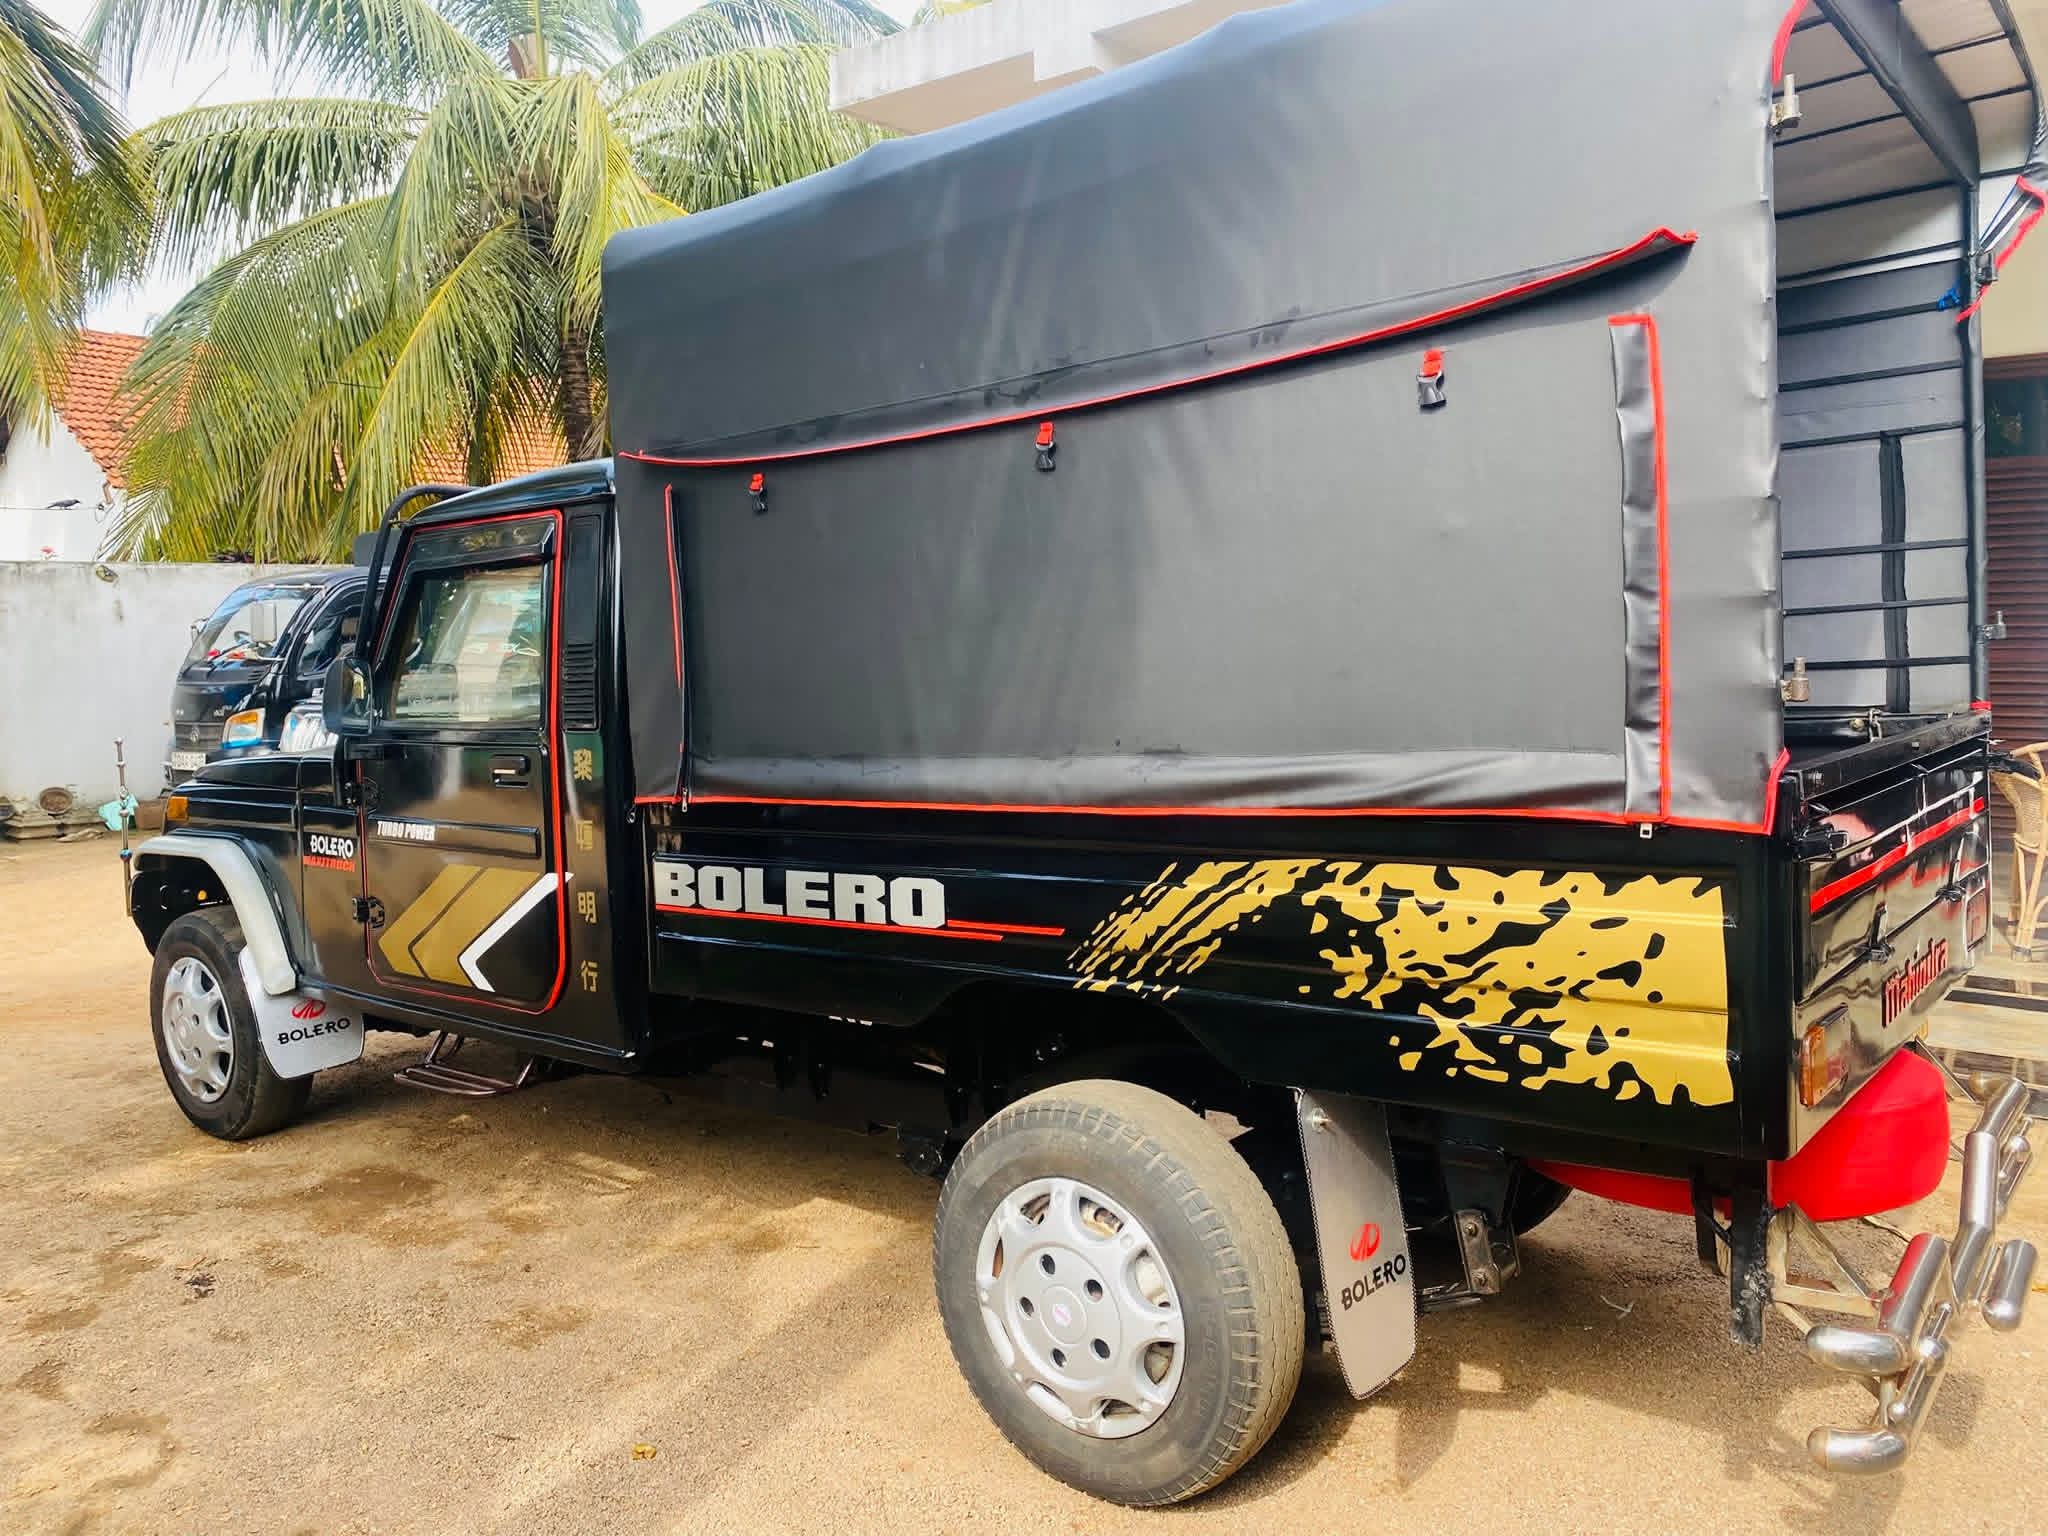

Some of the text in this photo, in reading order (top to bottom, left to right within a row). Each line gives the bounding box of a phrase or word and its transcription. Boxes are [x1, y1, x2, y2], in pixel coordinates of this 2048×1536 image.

[310, 834, 354, 859] BOLERO
[377, 820, 436, 841] TURBO POWER
[653, 861, 945, 929] BOLERO
[1881, 938, 1948, 1029] Mahindra
[278, 1017, 351, 1045] BOLERO
[1341, 1254, 1406, 1311] BOLERO
